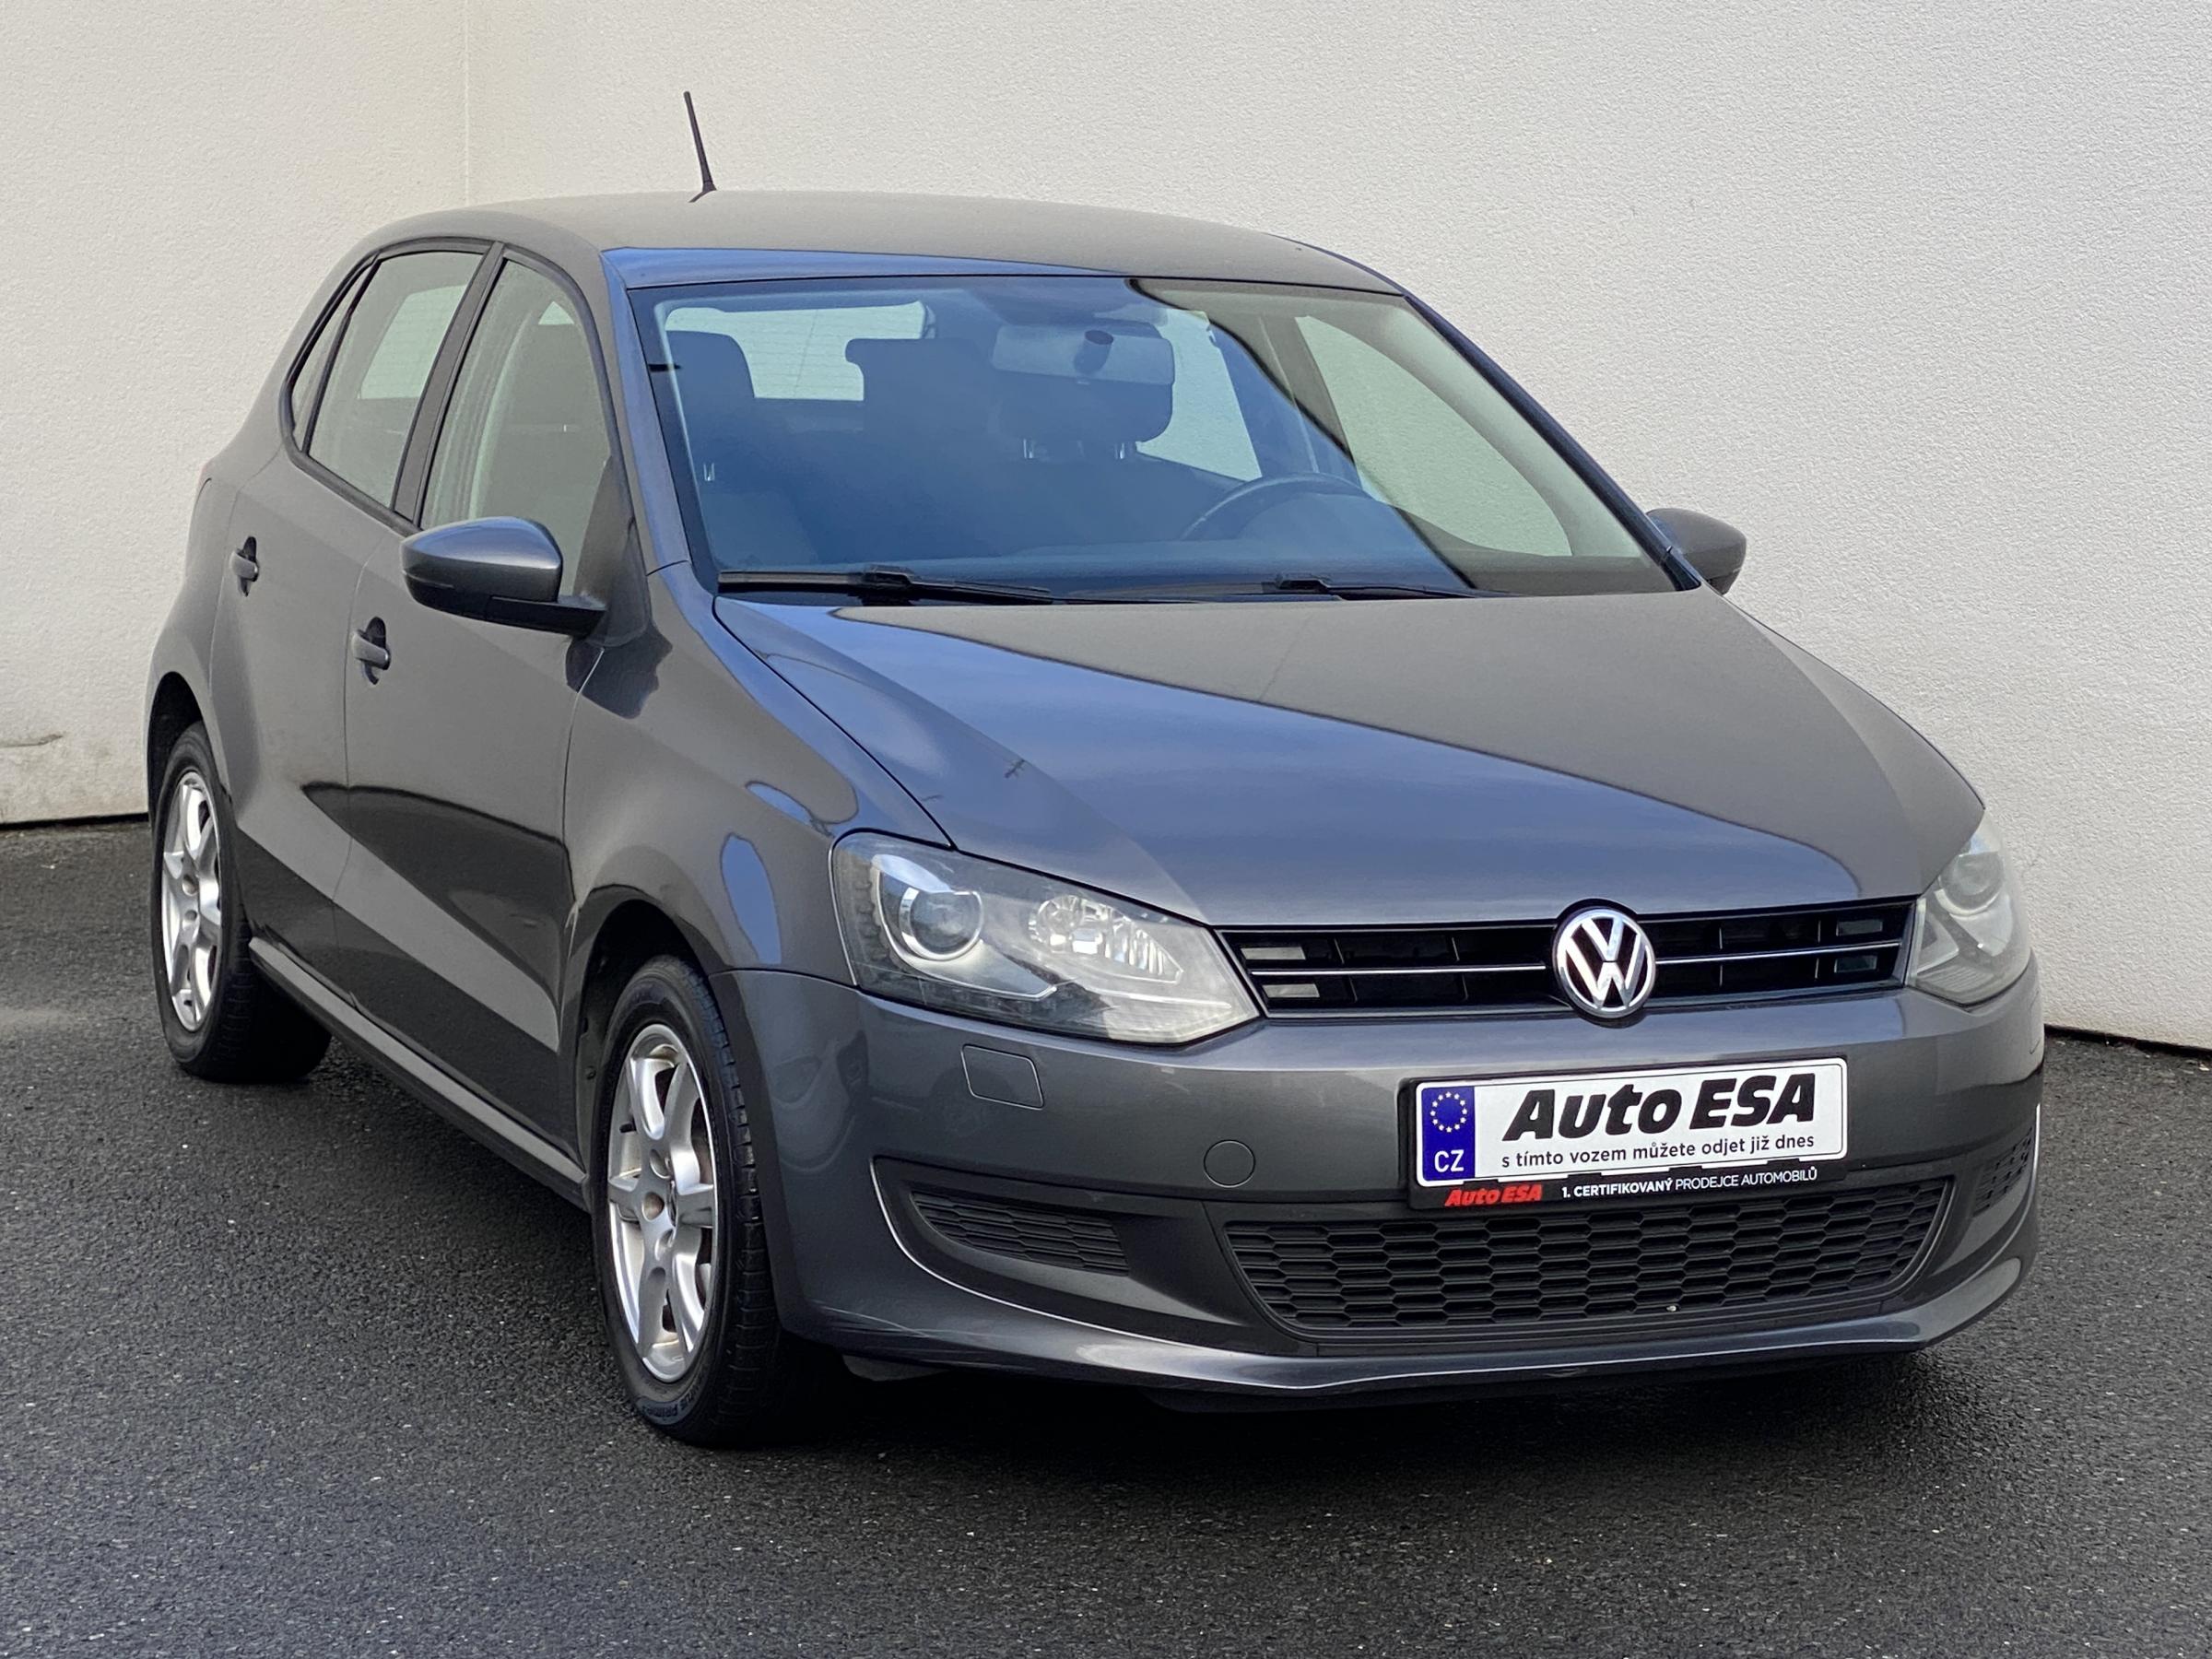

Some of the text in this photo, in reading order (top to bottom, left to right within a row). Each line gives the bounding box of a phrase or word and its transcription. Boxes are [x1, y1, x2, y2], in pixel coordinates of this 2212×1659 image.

[1501, 1073, 1816, 1141] Auto ESA
[1434, 1149, 1465, 1172] CZ
[1501, 1135, 1815, 1168] s tímto vozem můžete odjet již dnes
[1444, 1183, 1544, 1206] Auto ESA
[1561, 1166, 1818, 1198] 1. CERTIFIKOVANÝ PRODEJCE AUTOMOBILŮ
